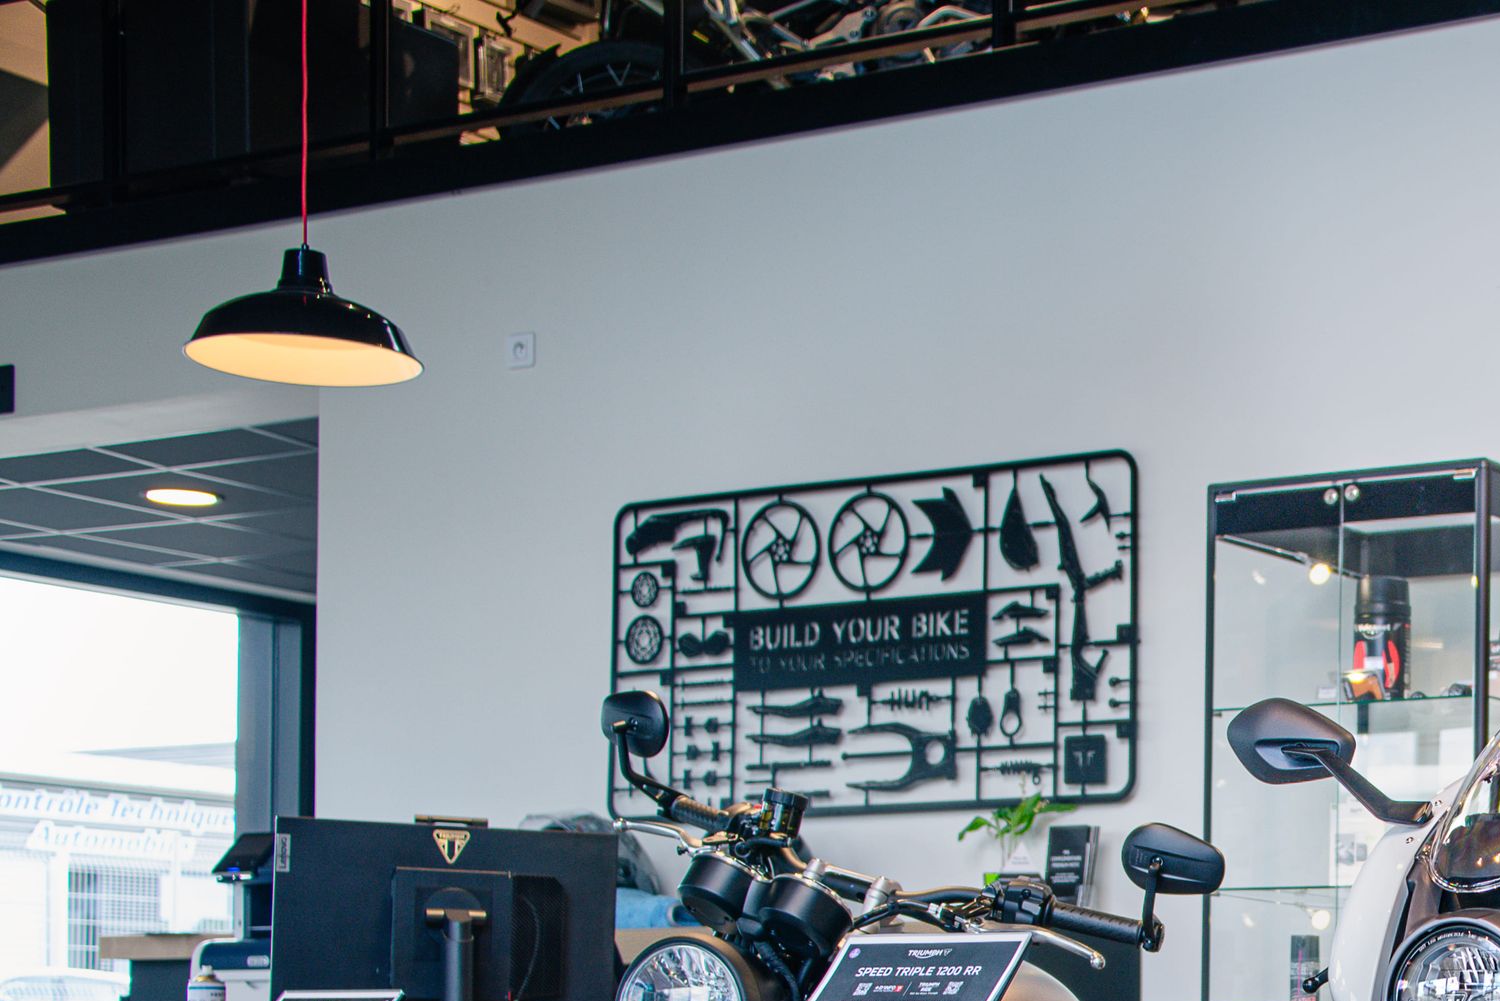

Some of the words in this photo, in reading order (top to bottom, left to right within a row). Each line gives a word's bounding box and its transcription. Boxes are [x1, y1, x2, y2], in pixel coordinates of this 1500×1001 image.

[749, 622, 821, 651] BUILD
[832, 615, 901, 645] YOUR
[911, 609, 969, 639] BIKE
[749, 656, 771, 674] TO
[779, 651, 826, 673] YOUR
[833, 641, 970, 669] SPECIFICATIONS
[0, 790, 98, 817] ontrôle
[908, 949, 944, 959] TRIUMPH
[855, 967, 893, 977] SPEED
[894, 966, 936, 977] TRIPLE
[937, 966, 962, 976] 1200
[963, 965, 982, 976] RR
